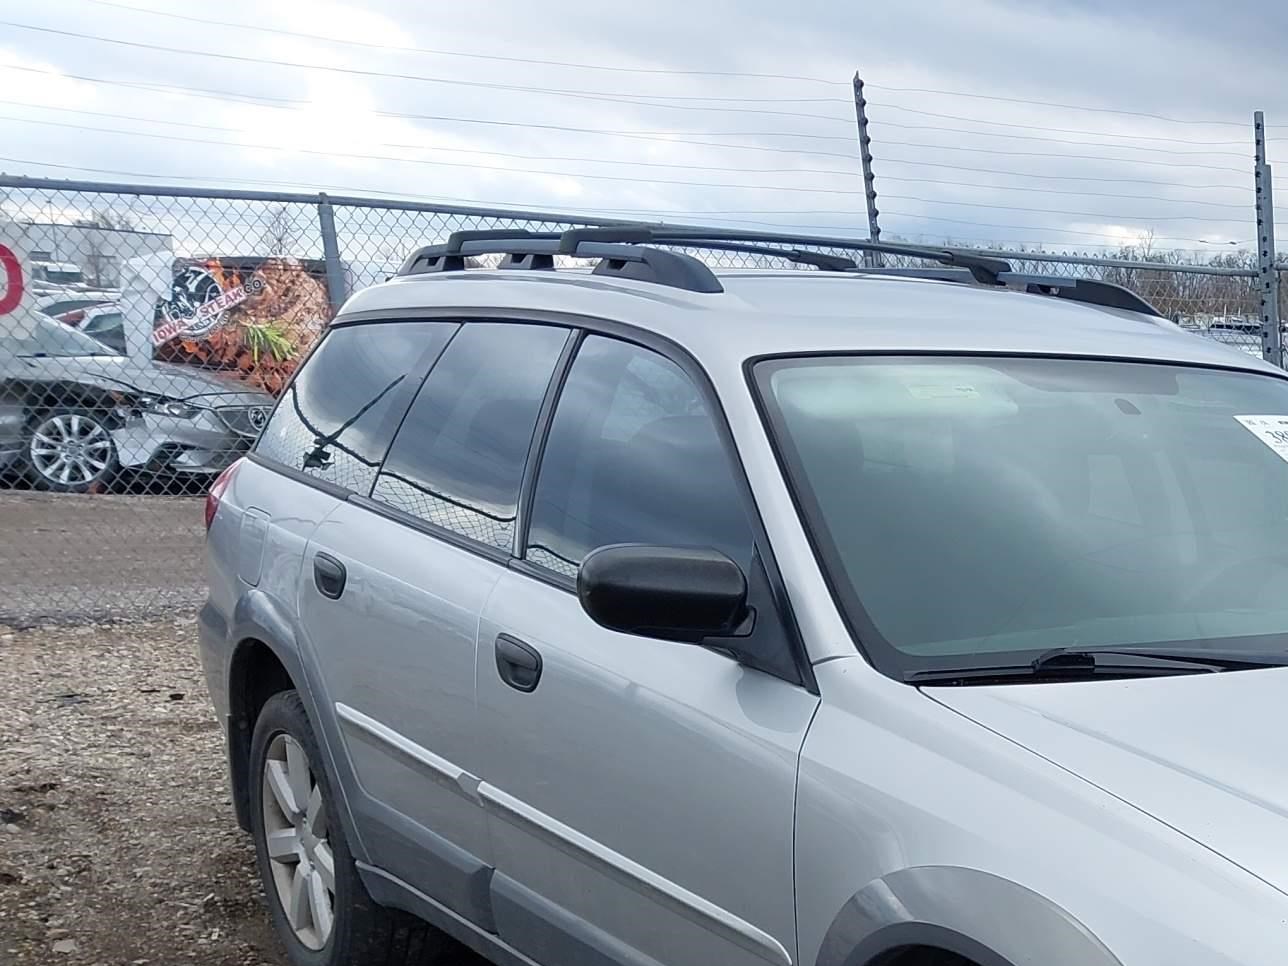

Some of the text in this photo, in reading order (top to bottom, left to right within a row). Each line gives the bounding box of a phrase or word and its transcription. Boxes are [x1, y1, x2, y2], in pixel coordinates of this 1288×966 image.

[152, 318, 188, 343] IOWA
[198, 288, 243, 317] STEAK
[243, 278, 266, 295] CO.
